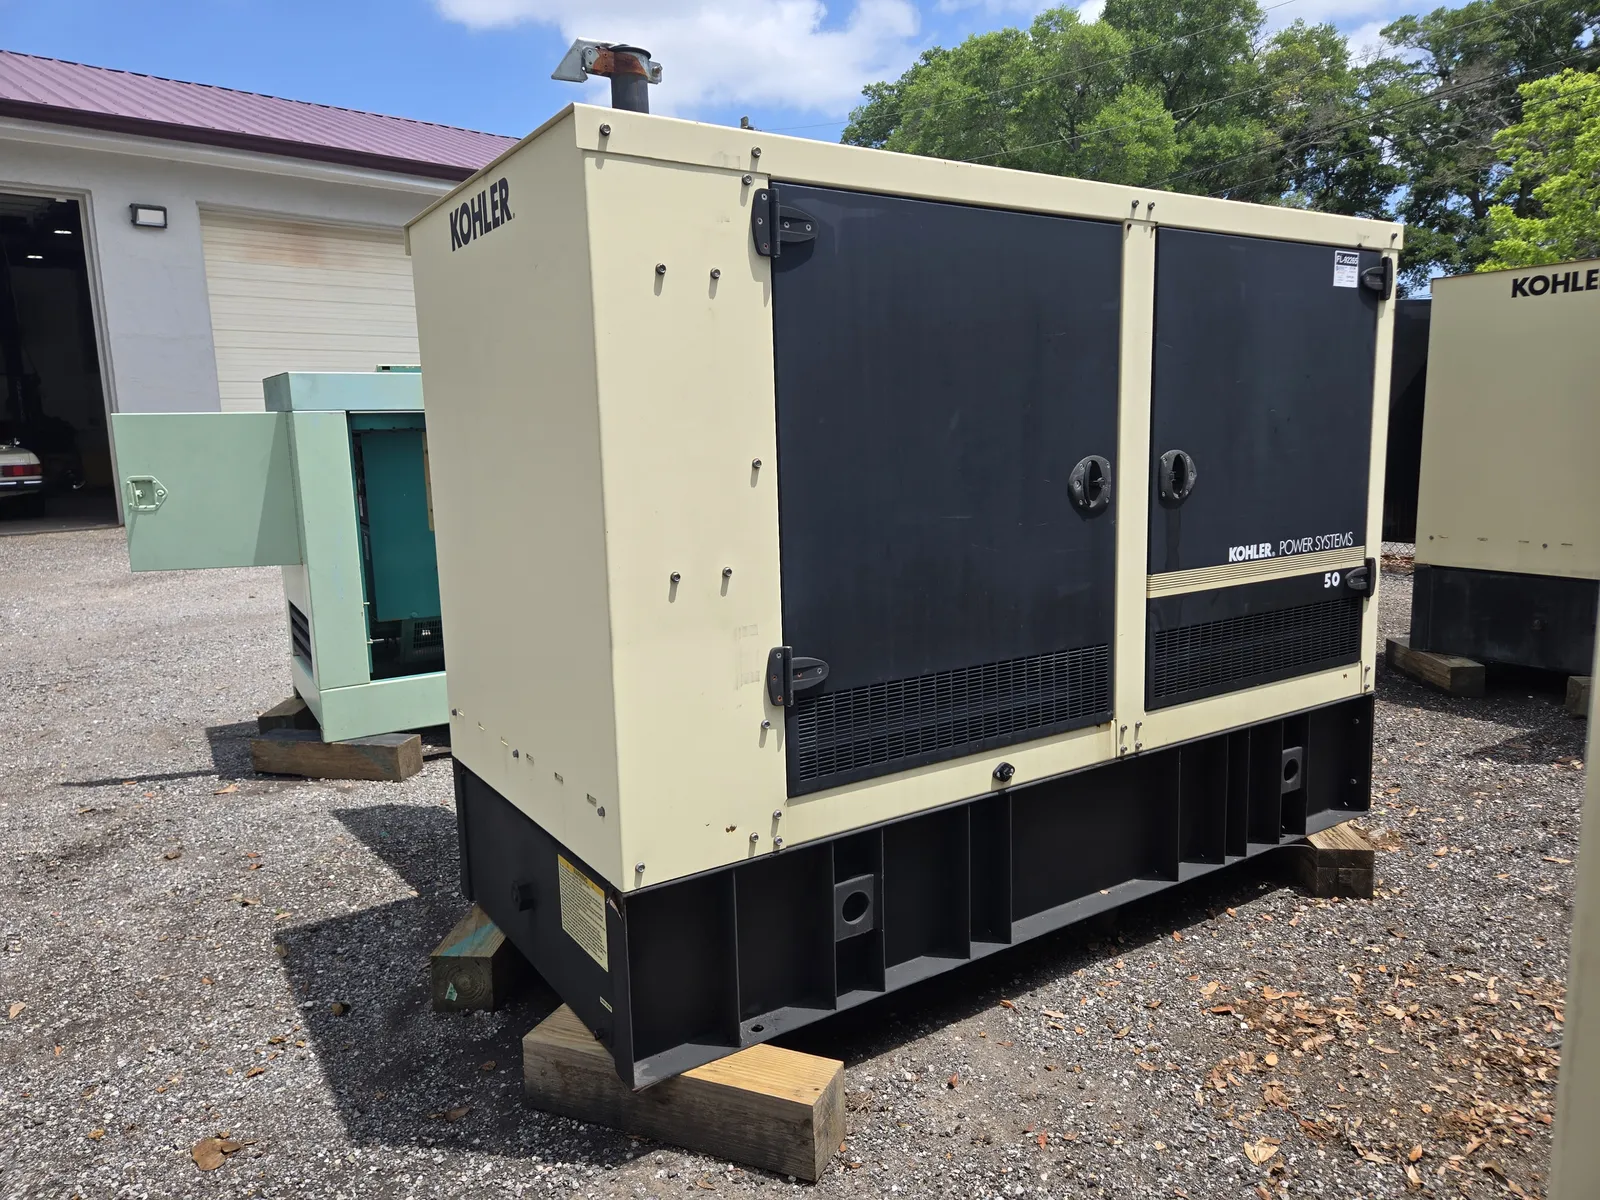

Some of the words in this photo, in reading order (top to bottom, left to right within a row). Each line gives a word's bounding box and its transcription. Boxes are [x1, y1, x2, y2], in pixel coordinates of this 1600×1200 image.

[449, 177, 512, 252] KOHLER
[1511, 268, 1600, 298] KOHLE
[1228, 543, 1272, 562] KOHLER
[1279, 537, 1314, 555] POWER
[1314, 531, 1354, 551] SYSTEMS
[1324, 572, 1340, 588] 50
